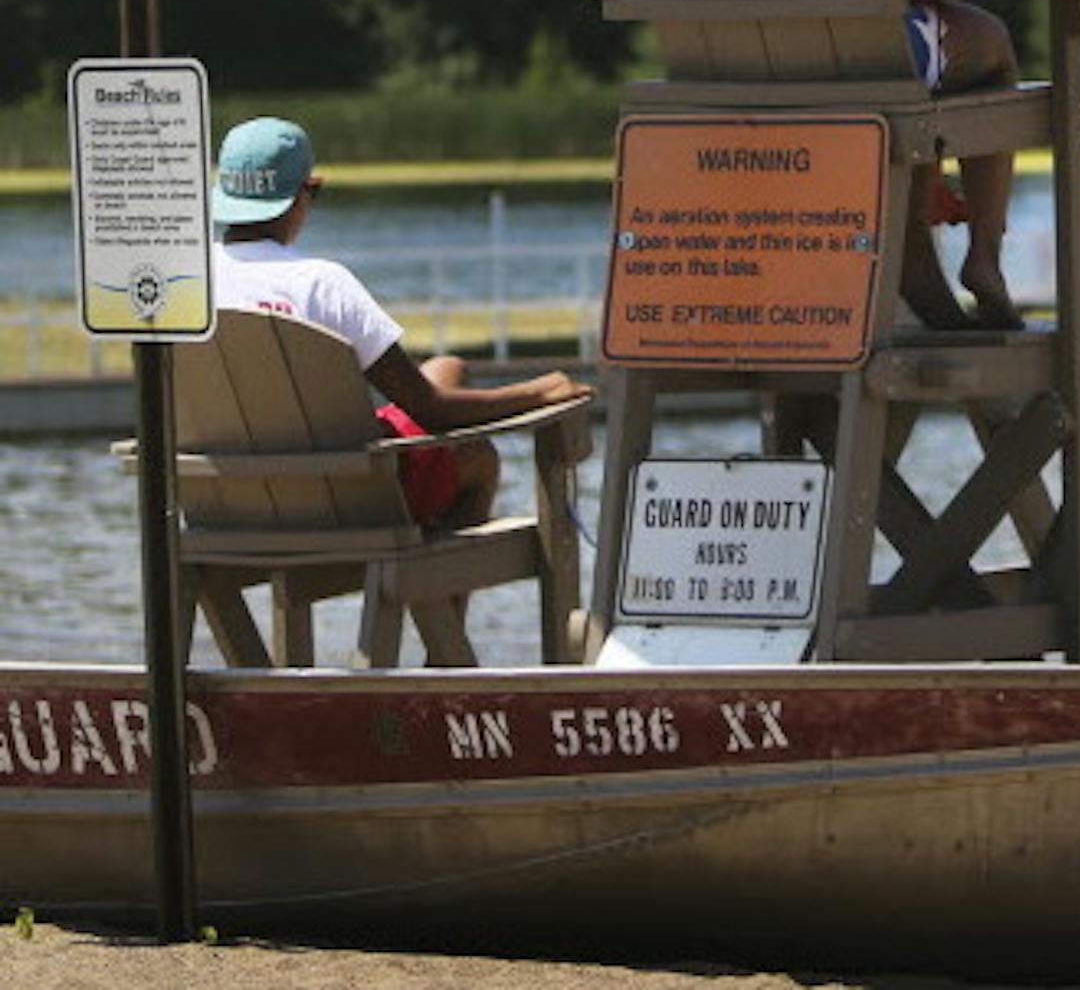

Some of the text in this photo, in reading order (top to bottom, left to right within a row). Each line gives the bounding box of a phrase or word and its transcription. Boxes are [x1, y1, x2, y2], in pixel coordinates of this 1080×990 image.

[697, 148, 811, 172] WARNING
[631, 207, 866, 229] An aeration system creating
[676, 234, 722, 250] water
[724, 233, 756, 250] and
[796, 233, 823, 251] ice
[828, 233, 842, 251] is
[625, 260, 656, 276] use
[659, 260, 682, 276] on
[687, 257, 719, 277] this
[626, 304, 853, 326] USE EXTREME CAUTION
[645, 499, 810, 530] GUARD ON DUTY
[695, 542, 748, 565] HOURS
[688, 577, 709, 601] TO
[445, 700, 789, 759] MN 5586 XX
